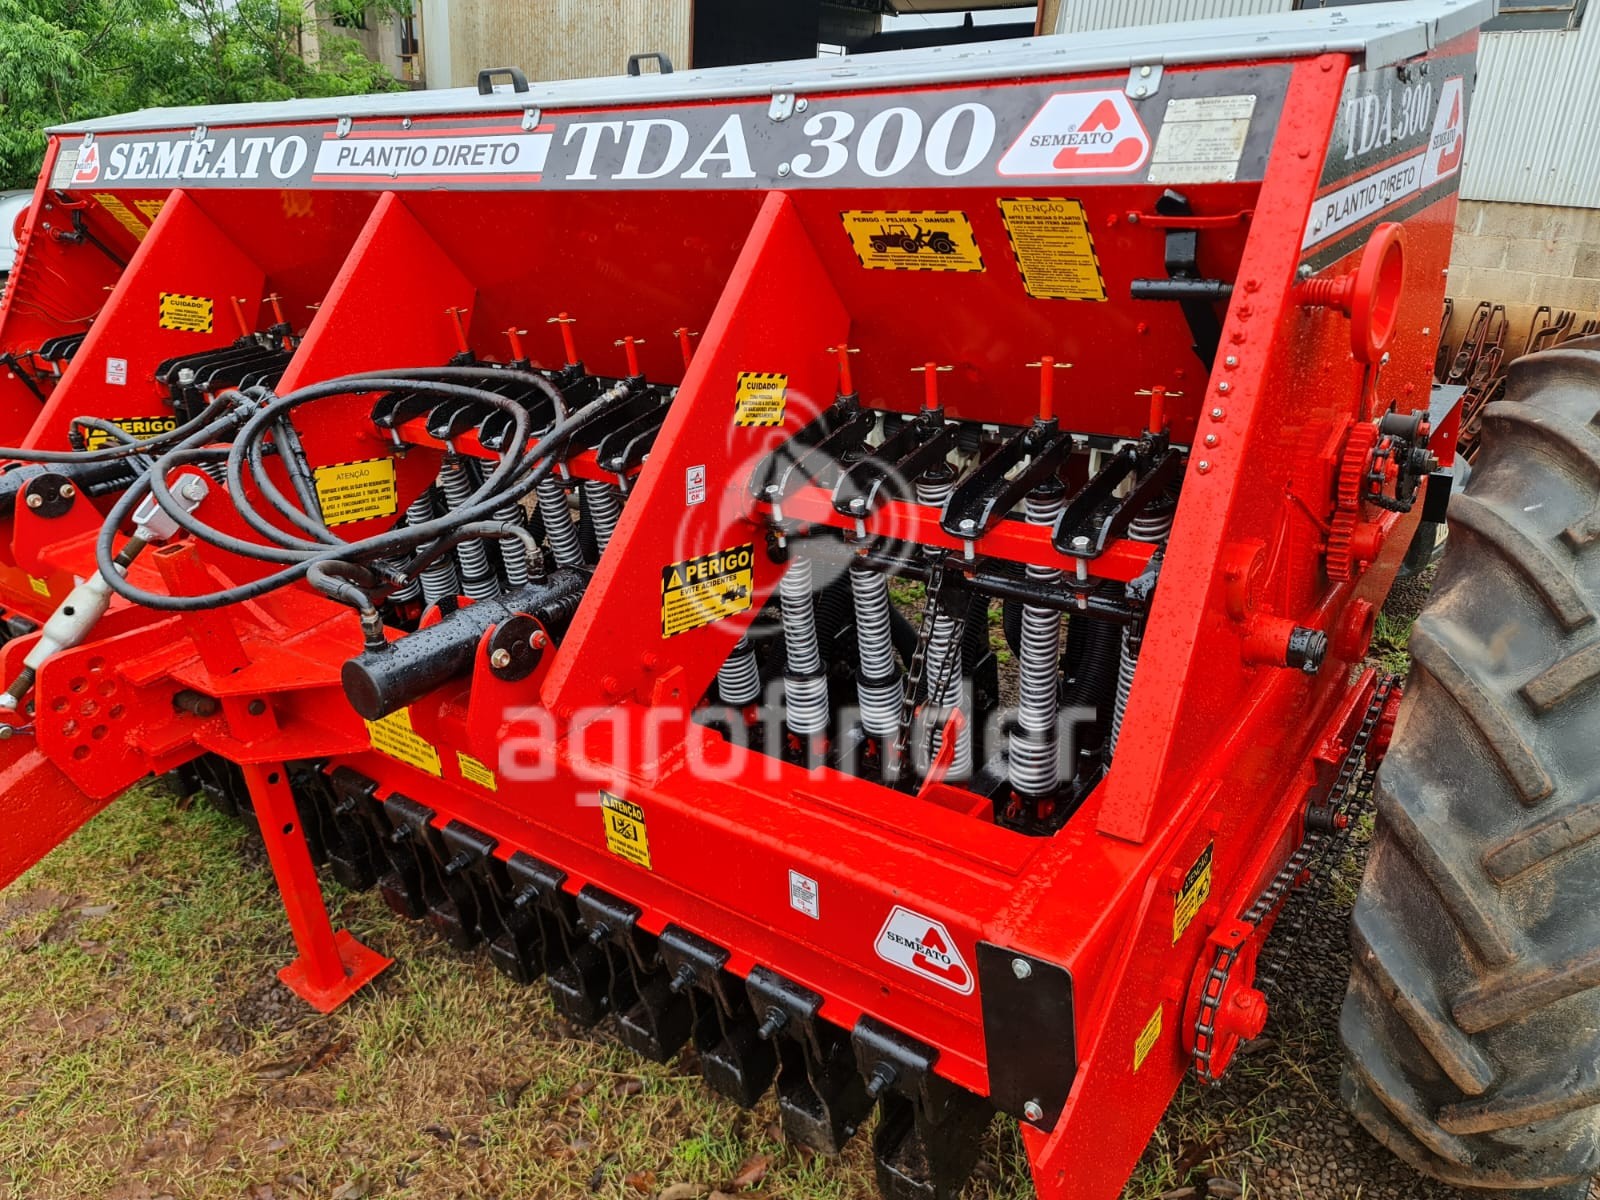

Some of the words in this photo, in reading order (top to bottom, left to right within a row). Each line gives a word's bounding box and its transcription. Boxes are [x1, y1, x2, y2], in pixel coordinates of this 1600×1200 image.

[1344, 89, 1393, 160] TDA
[1398, 81, 1432, 140] 300
[562, 113, 756, 181] TDA
[791, 103, 996, 178] 300
[1030, 131, 1113, 147] SEMEATO
[104, 135, 307, 180] SEMEATO
[336, 146, 427, 167] PLANTIO
[432, 143, 520, 167] DIRETO
[1325, 183, 1377, 227] PLANTIO
[1378, 165, 1416, 199] DIRETO
[1012, 203, 1064, 214] ATENÇÃO
[170, 299, 204, 308] CUIDADO!
[746, 382, 778, 390] CUIDADO!
[336, 469, 369, 481] ATENÇÃO
[686, 550, 749, 583] PERIGO
[680, 584, 700, 596] EVITE
[701, 573, 737, 590] ACIDENTES
[610, 797, 642, 820] ATENÇÃO
[1183, 852, 1209, 892] ATENÇÃO
[886, 930, 951, 965] SEMEATO
